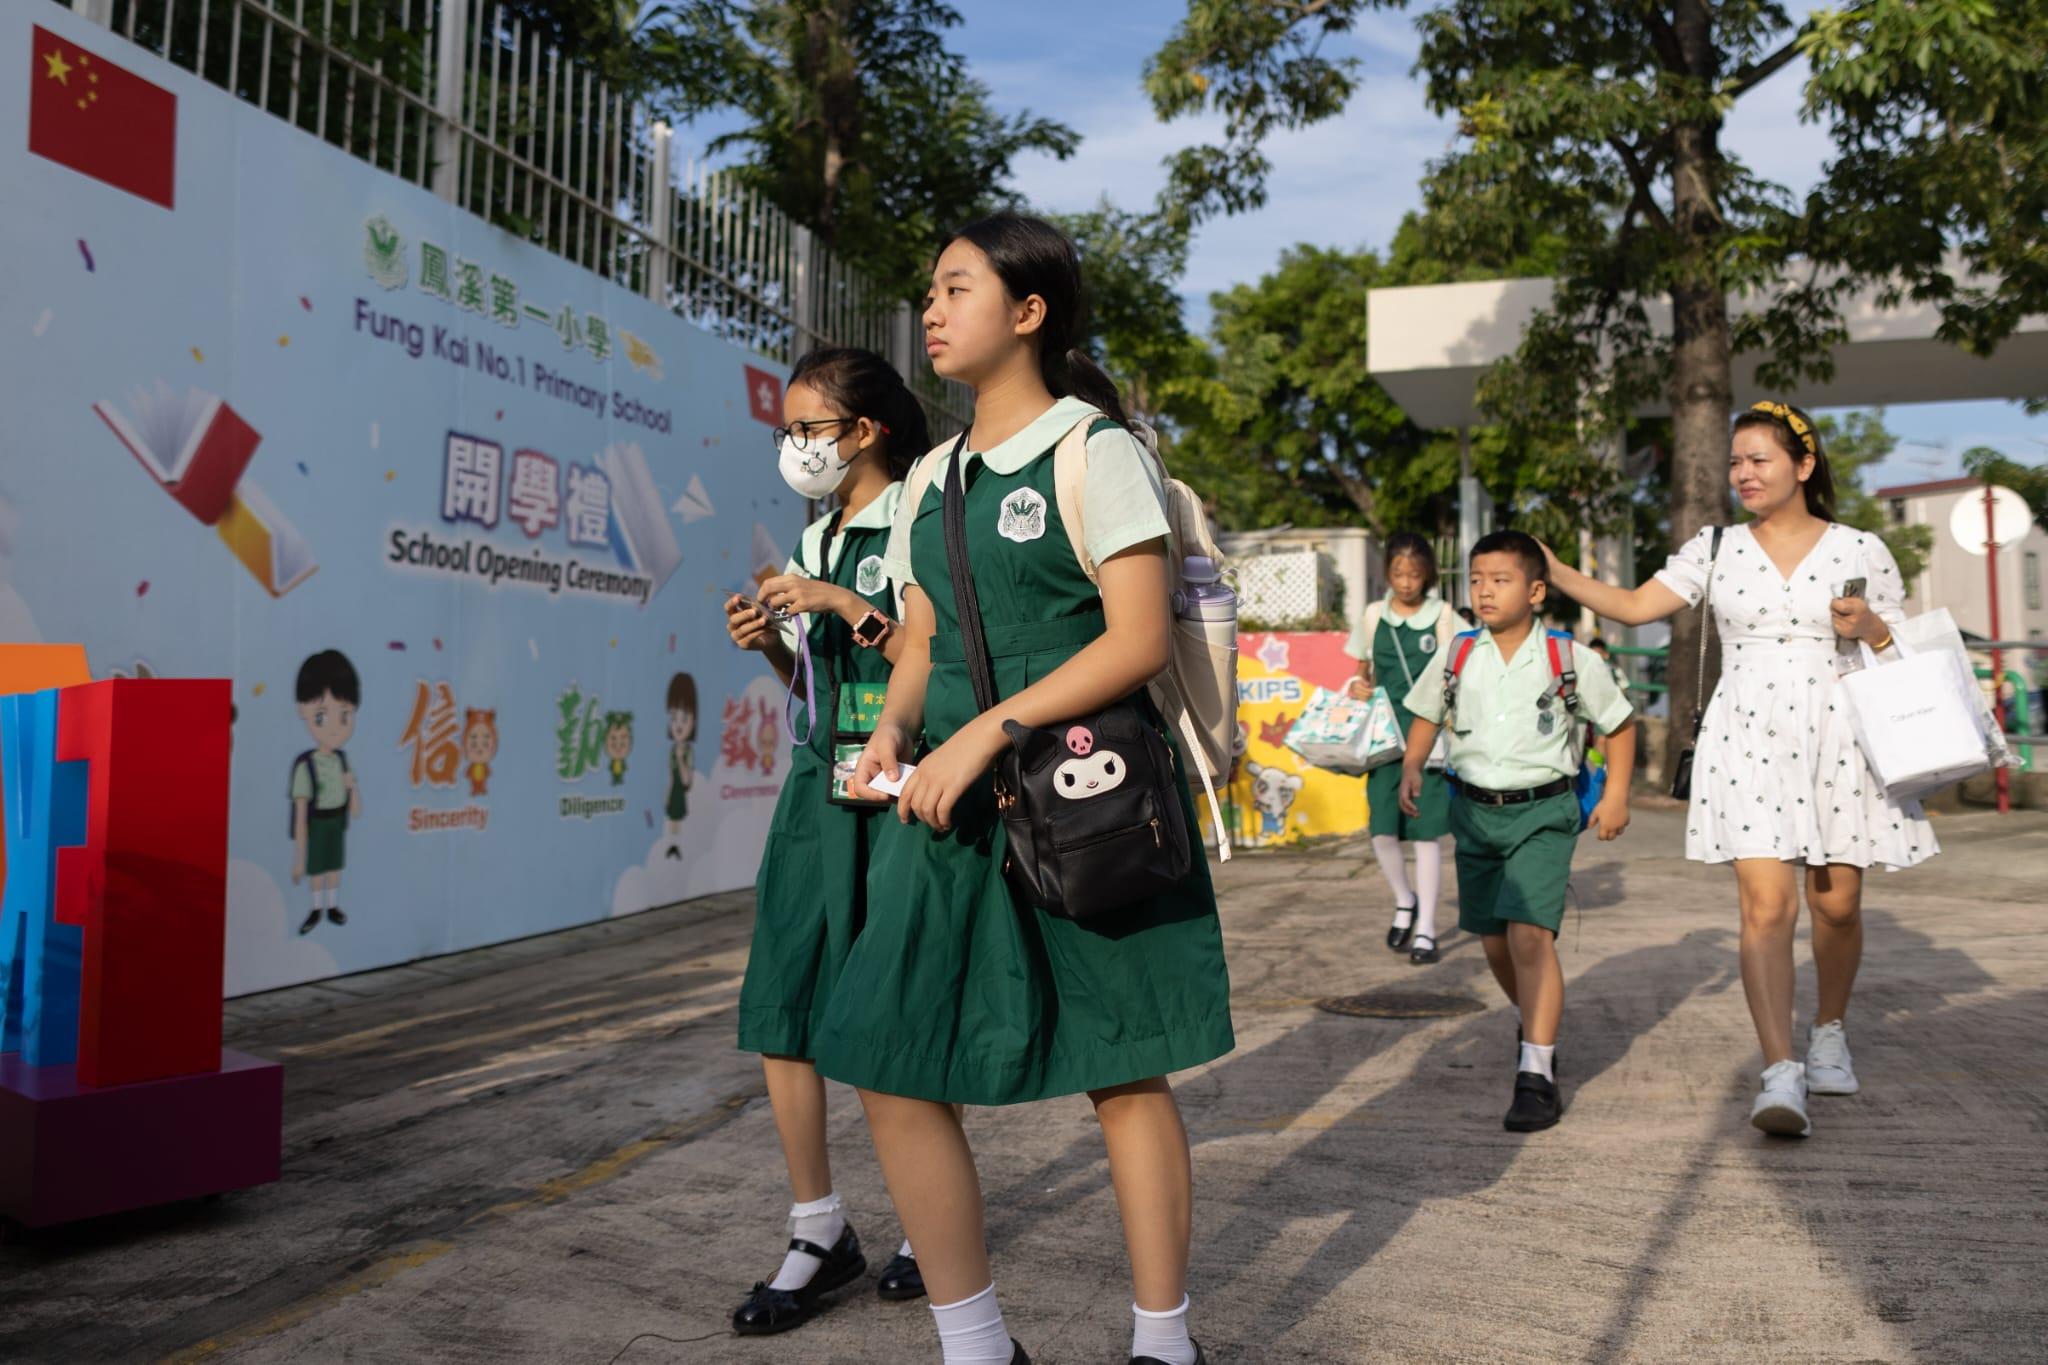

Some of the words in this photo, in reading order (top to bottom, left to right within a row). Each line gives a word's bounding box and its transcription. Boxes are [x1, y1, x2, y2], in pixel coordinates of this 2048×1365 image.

[418, 240, 613, 362] 鳳溪第一小學
[355, 298, 424, 358] Fung
[433, 324, 469, 367] Kai
[477, 341, 526, 387] No.1
[534, 362, 607, 418] Primary
[612, 391, 672, 435] School
[441, 430, 612, 549] 開學禮
[389, 530, 470, 574] School
[476, 544, 562, 593] Opening
[567, 560, 652, 604] Ceremony
[399, 682, 460, 786] 信
[408, 806, 489, 832] Sincerity
[559, 796, 625, 819] Diligence
